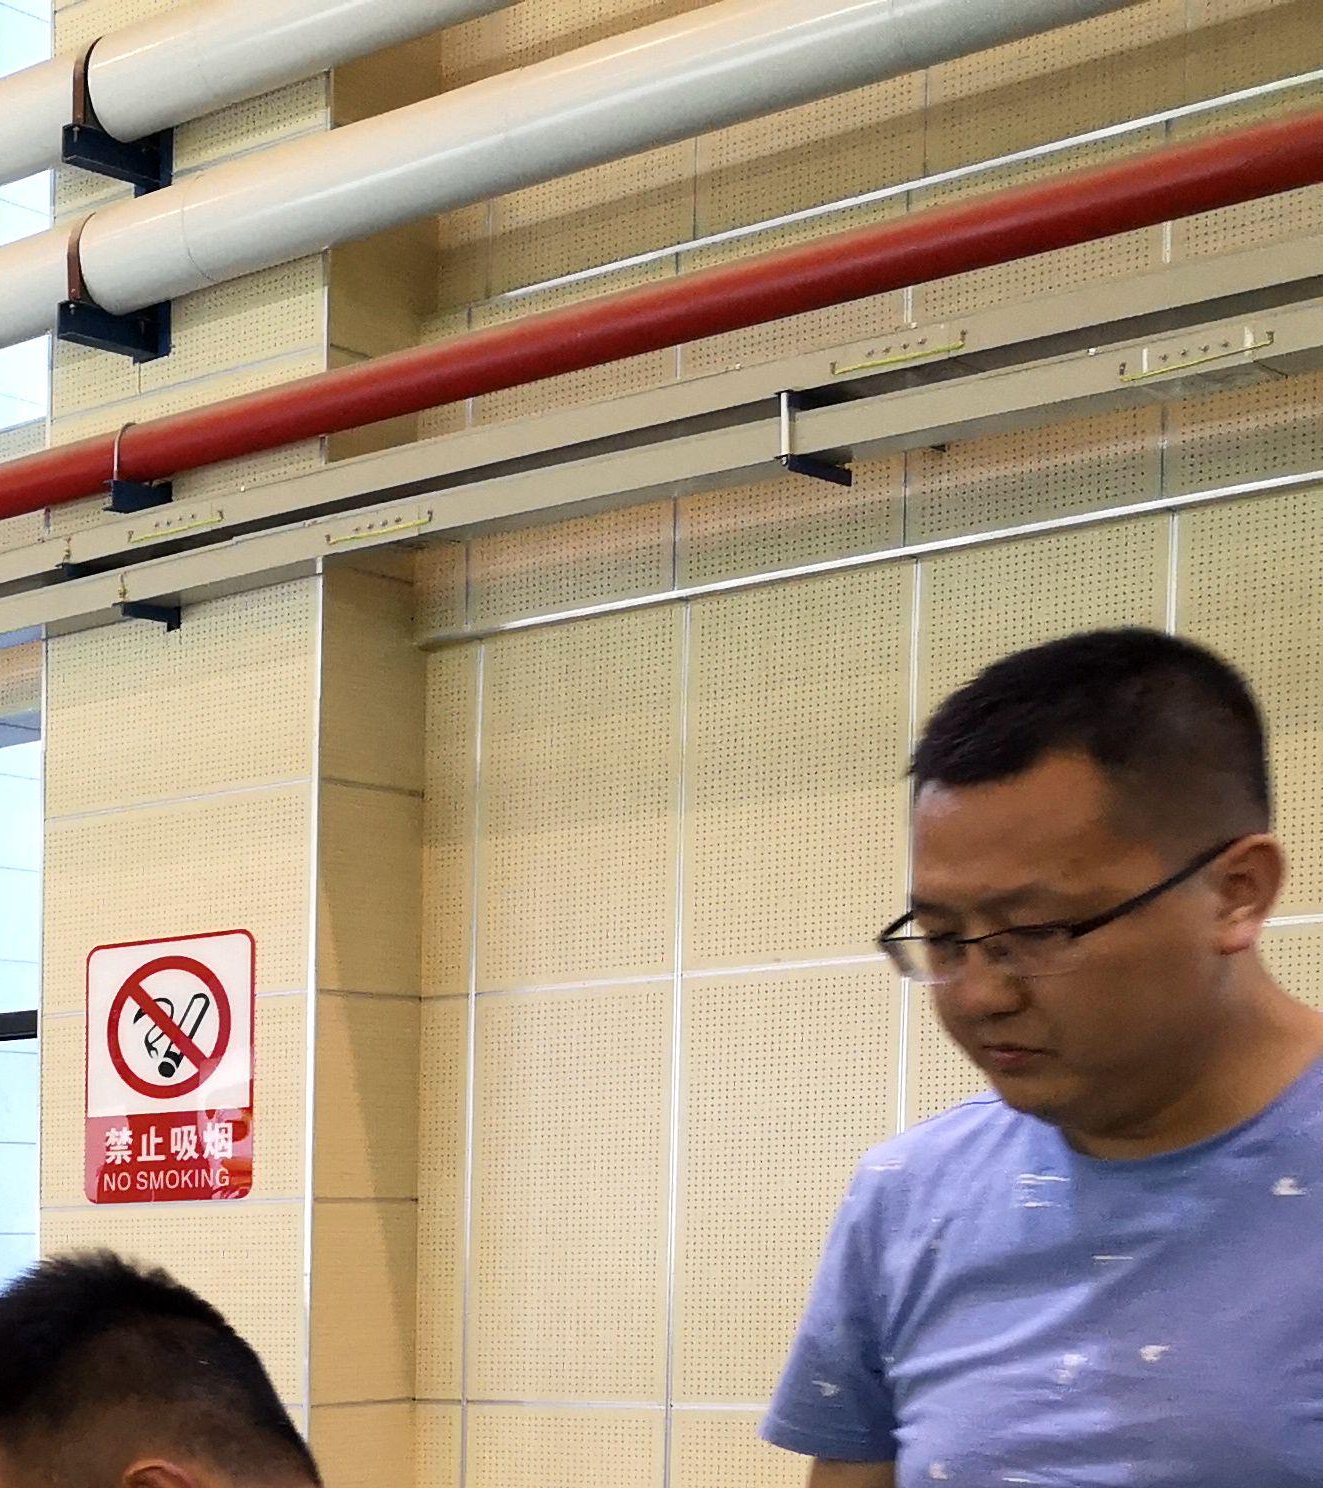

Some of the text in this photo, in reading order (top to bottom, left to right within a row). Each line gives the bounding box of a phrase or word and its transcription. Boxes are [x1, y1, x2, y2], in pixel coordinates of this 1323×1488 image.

[105, 1122, 233, 1165] 禁止吸烟
[103, 1168, 230, 1192] NO SMOKING
